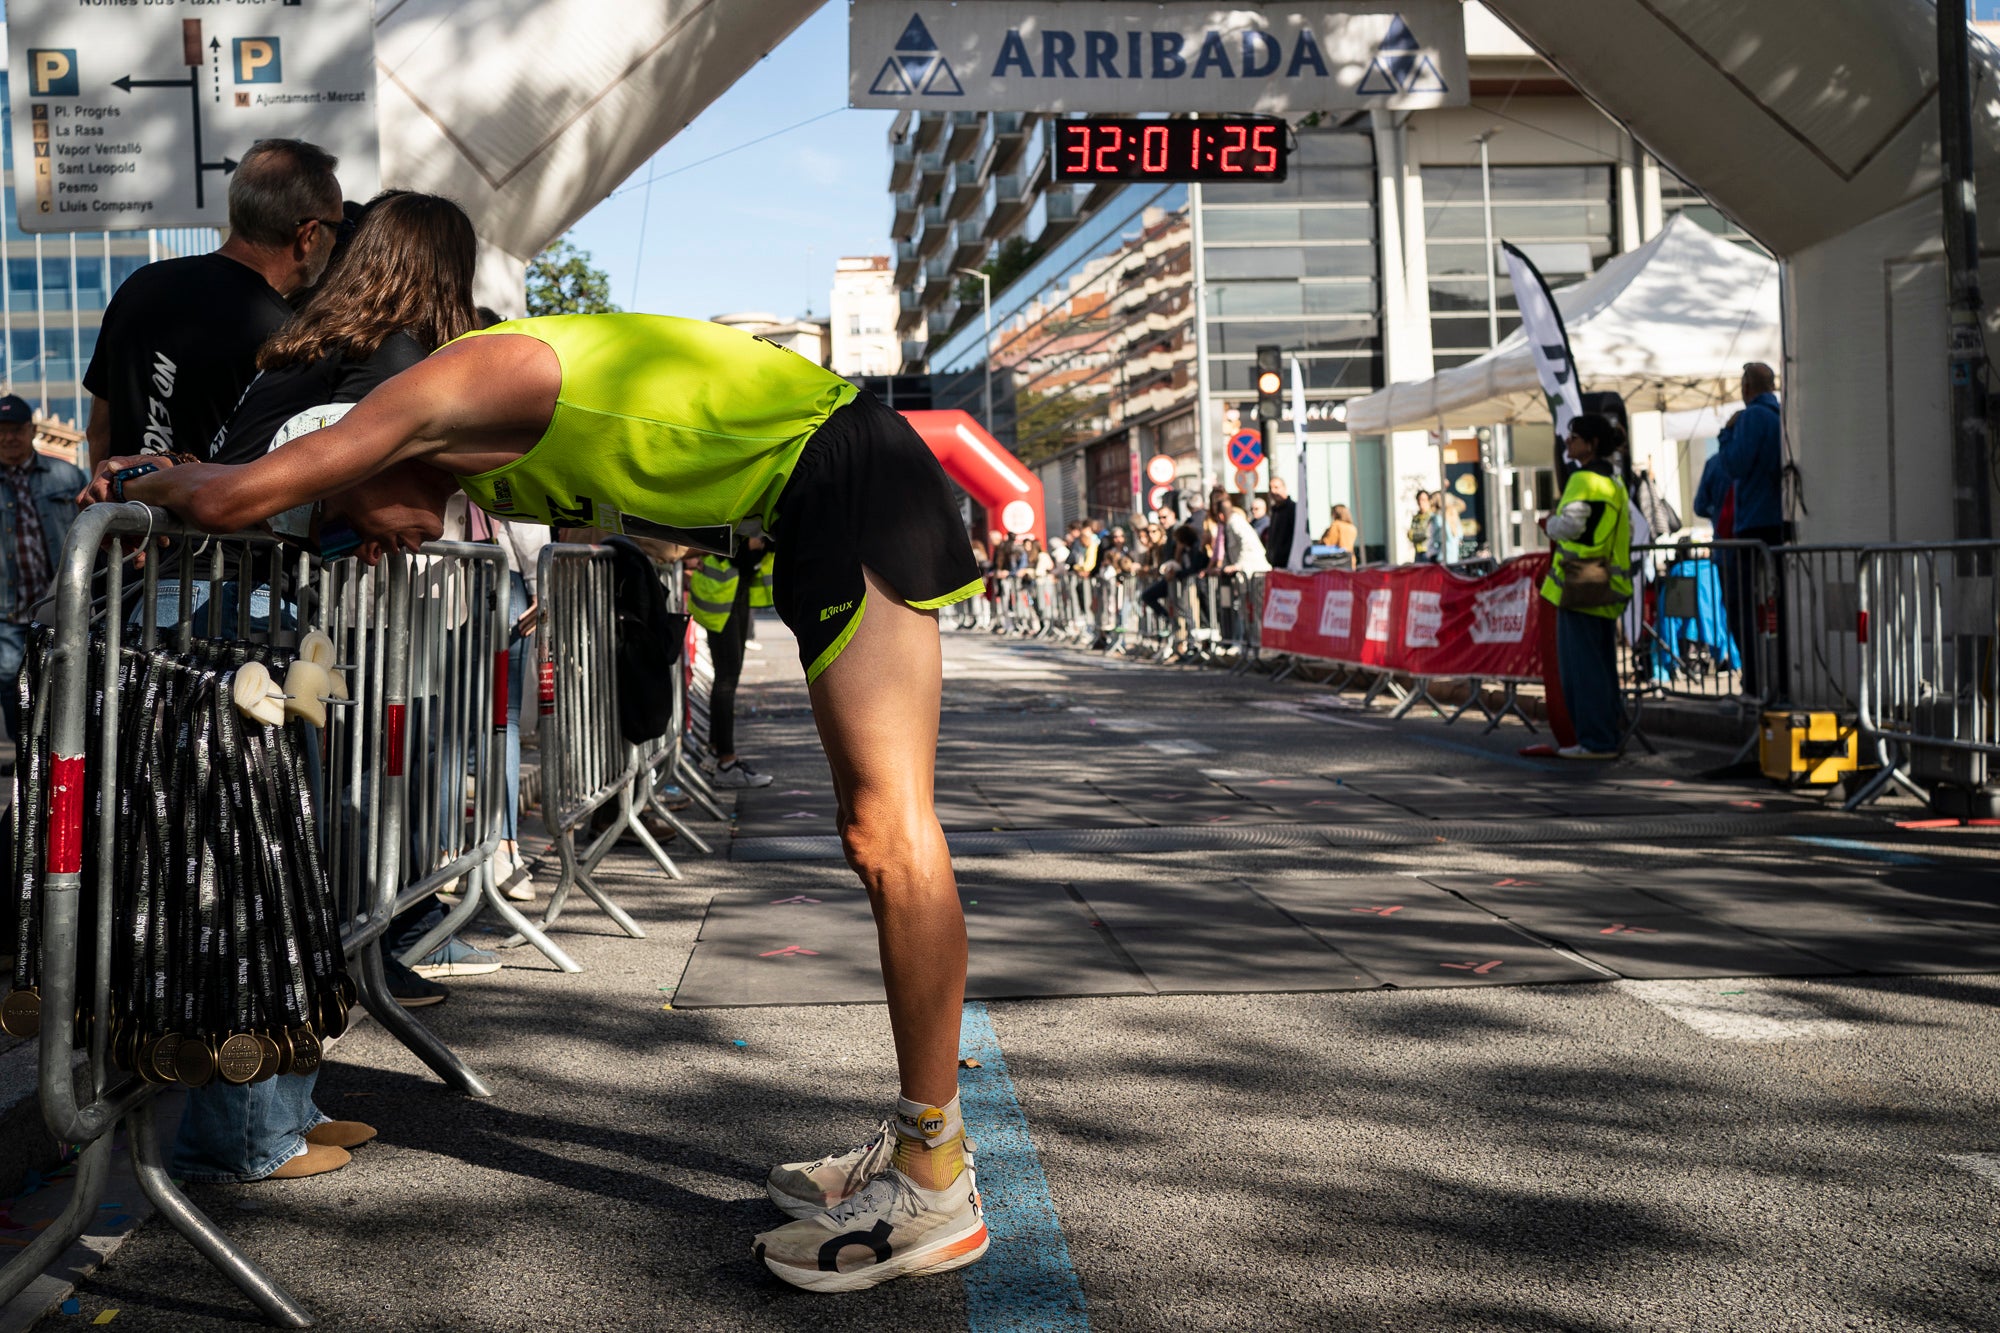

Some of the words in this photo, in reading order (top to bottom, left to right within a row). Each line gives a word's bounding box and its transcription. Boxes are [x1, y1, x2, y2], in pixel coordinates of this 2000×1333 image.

[36, 51, 70, 93] P
[241, 40, 273, 80] P
[991, 30, 1330, 79] ARRIBADA
[56, 125, 70, 137] La
[75, 125, 104, 136] Rasa
[56, 144, 91, 158] Vapor
[1066, 126, 1277, 172] 32:01:25
[58, 163, 84, 174] Sant
[88, 162, 135, 176] Leopold
[58, 182, 98, 194] Pesmo
[92, 200, 153, 214] Companys
[152, 351, 177, 398] NO
[140, 396, 174, 455] EXC
